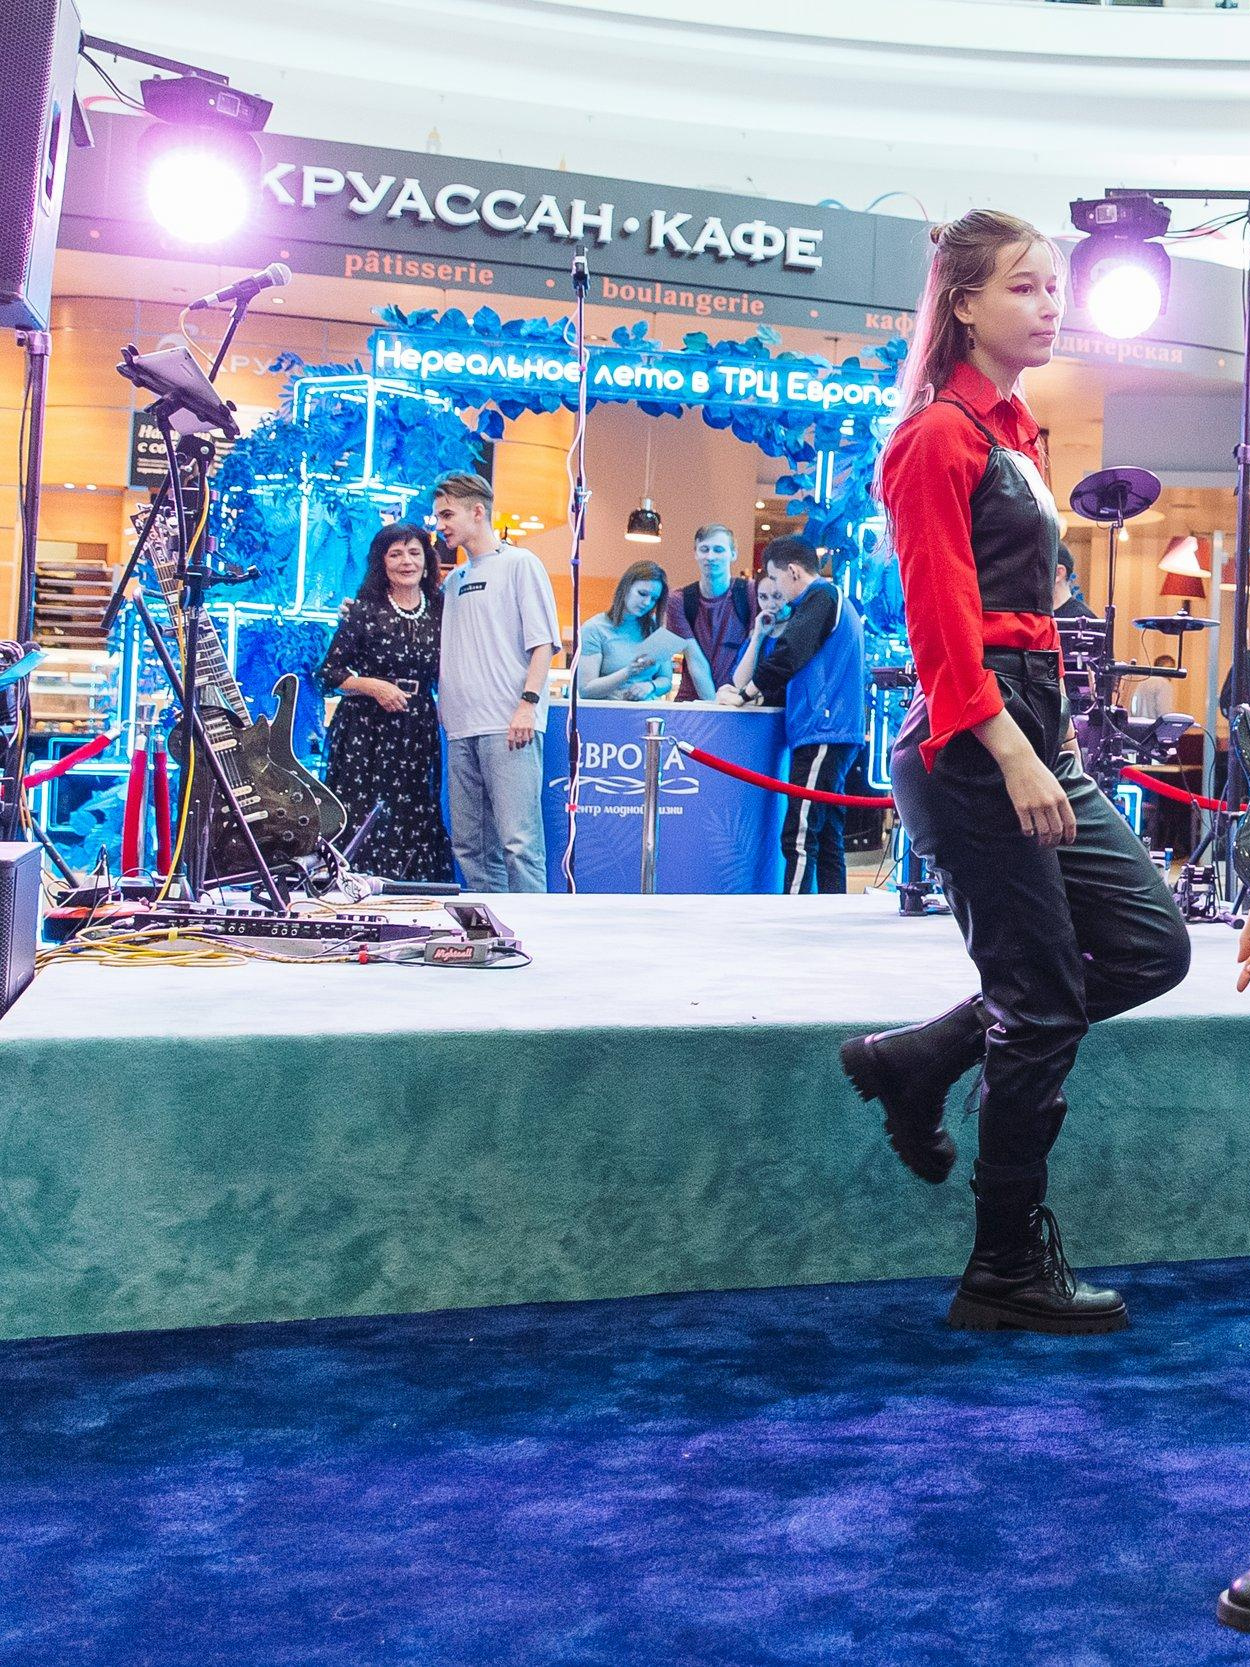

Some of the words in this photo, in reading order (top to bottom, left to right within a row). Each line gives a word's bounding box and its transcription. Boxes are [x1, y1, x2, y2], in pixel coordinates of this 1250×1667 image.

[262, 161, 614, 244] КРУАССАН
[650, 209, 823, 269] КАФЕ
[344, 250, 494, 285] pâtisserie
[602, 276, 765, 316] boulangerie
[864, 311, 914, 337] каф
[1055, 333, 1183, 364] дитерская
[377, 339, 582, 383] Нереальное
[594, 364, 684, 391] лето
[691, 371, 710, 393] в
[717, 366, 779, 404] ТРЦ
[787, 372, 901, 410] Европа
[578, 742, 685, 770] ВРОА
[658, 805, 683, 815] изни
